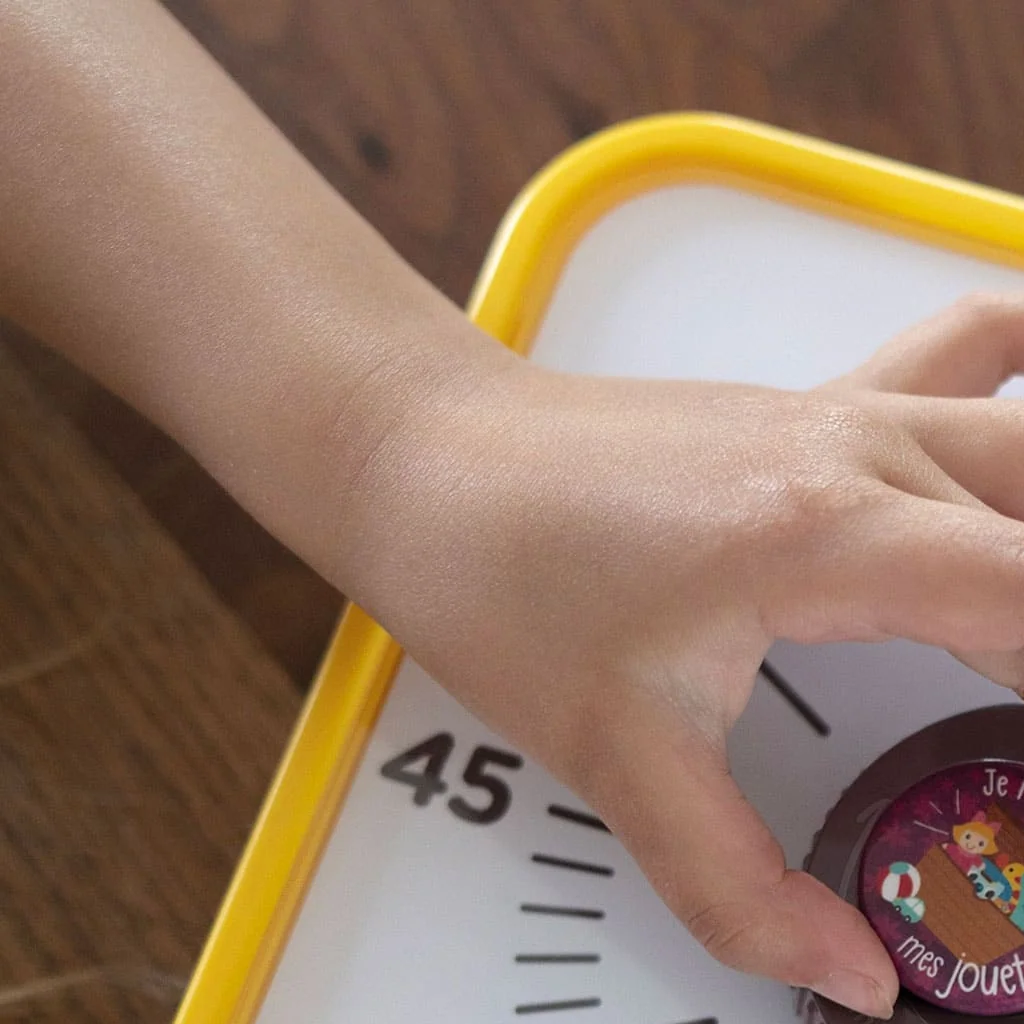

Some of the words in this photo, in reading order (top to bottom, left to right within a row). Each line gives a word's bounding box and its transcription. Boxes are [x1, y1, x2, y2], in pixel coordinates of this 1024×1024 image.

[379, 731, 525, 826] 45
[982, 768, 1009, 798] Je
[897, 934, 945, 979] mes
